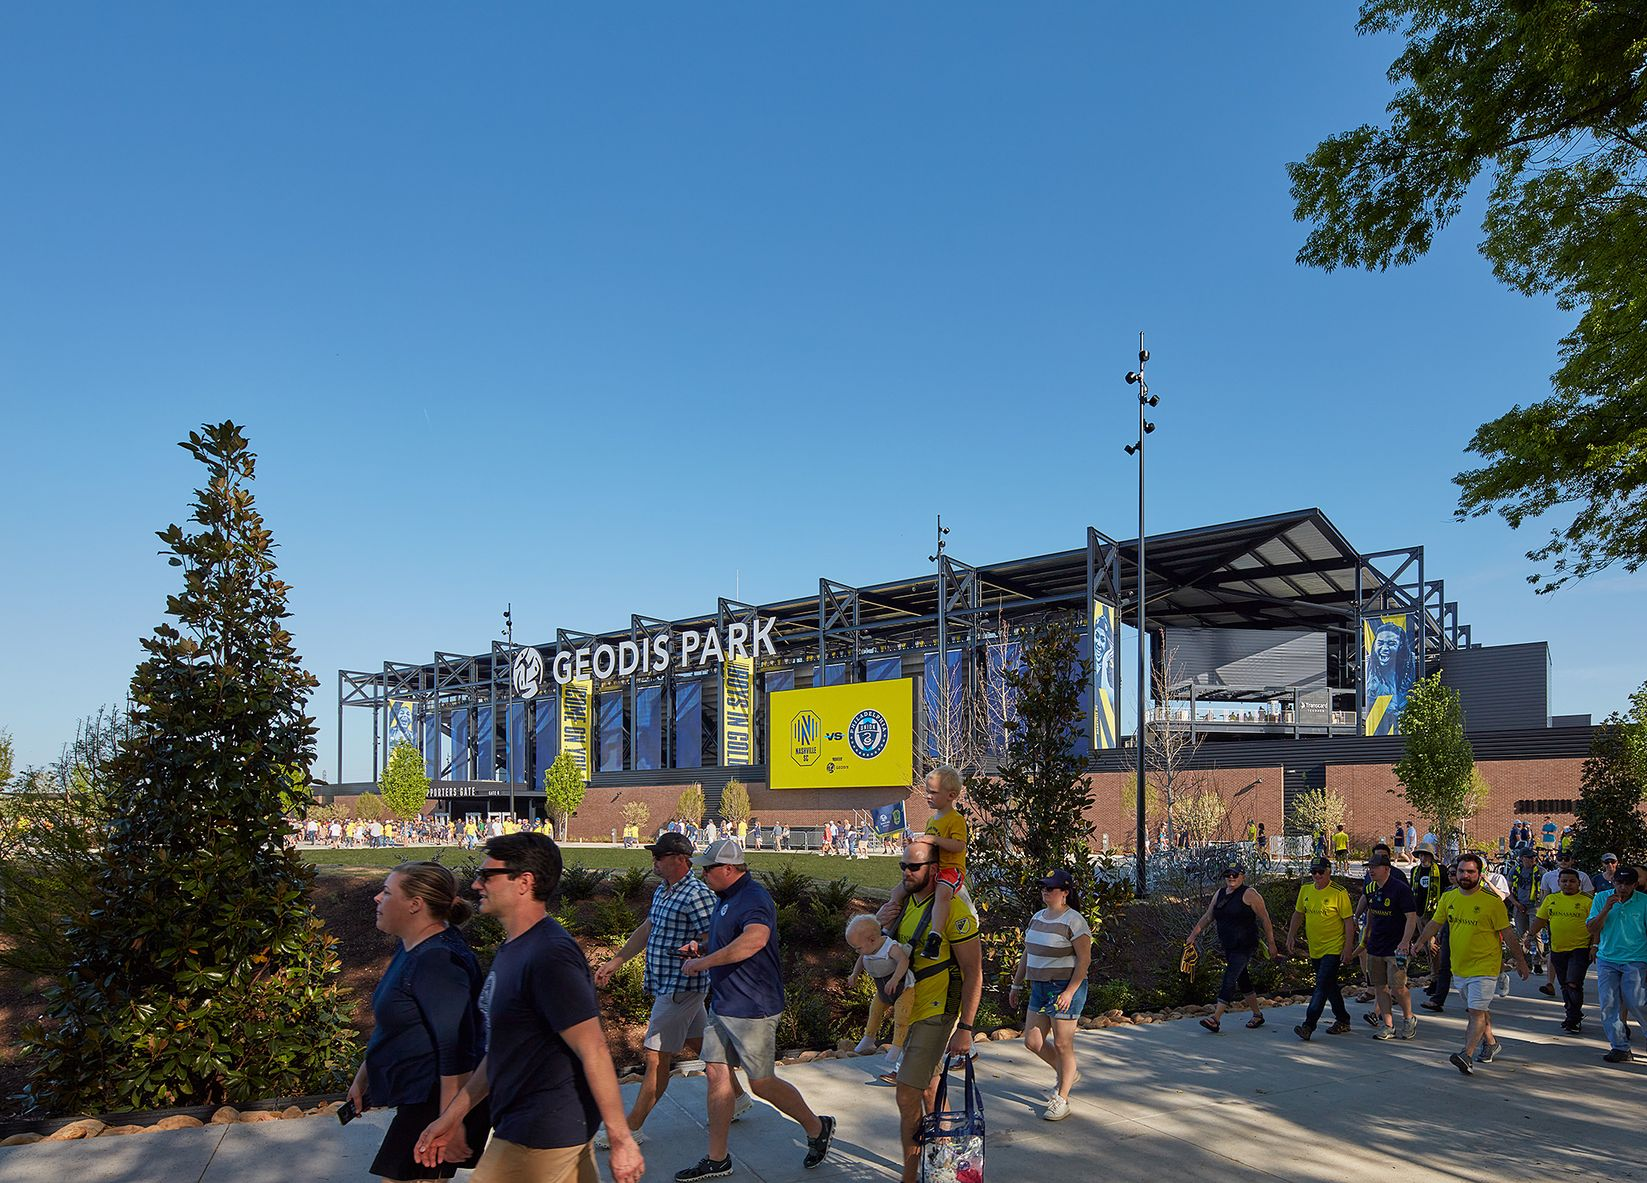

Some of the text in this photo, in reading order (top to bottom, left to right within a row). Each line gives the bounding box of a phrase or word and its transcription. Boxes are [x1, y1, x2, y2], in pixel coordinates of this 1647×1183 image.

[553, 616, 777, 684] GEODIS PARK
[727, 667, 749, 708] BOYS
[564, 689, 587, 723] COME
[727, 711, 749, 727] IN
[849, 711, 888, 734] PHILADELPHIA
[564, 726, 586, 743] ON
[795, 747, 817, 755] NASHVILLE
[426, 786, 475, 798] PPORTERS GATE
